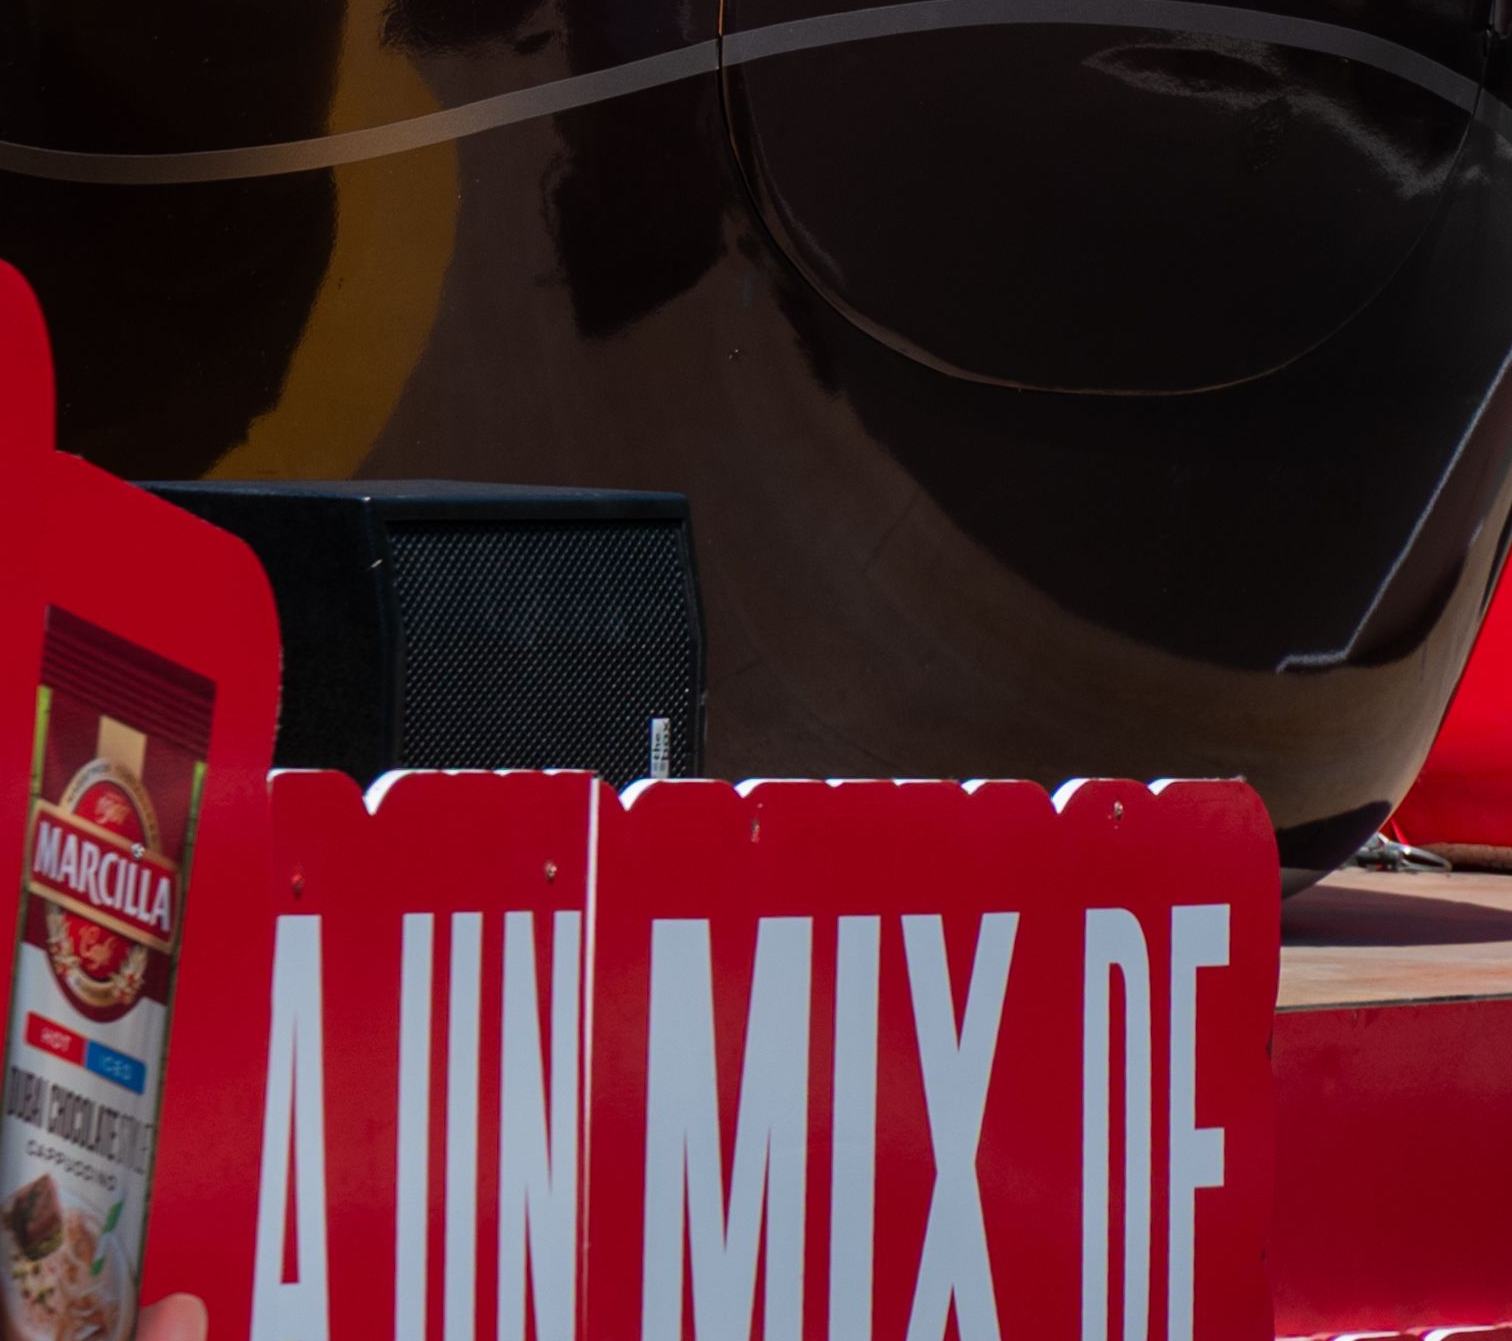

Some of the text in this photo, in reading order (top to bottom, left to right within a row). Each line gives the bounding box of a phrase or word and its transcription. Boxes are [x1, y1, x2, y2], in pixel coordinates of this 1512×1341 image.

[33, 820, 171, 932] MARCILLA
[249, 903, 1231, 1341] A UN MIX DE
